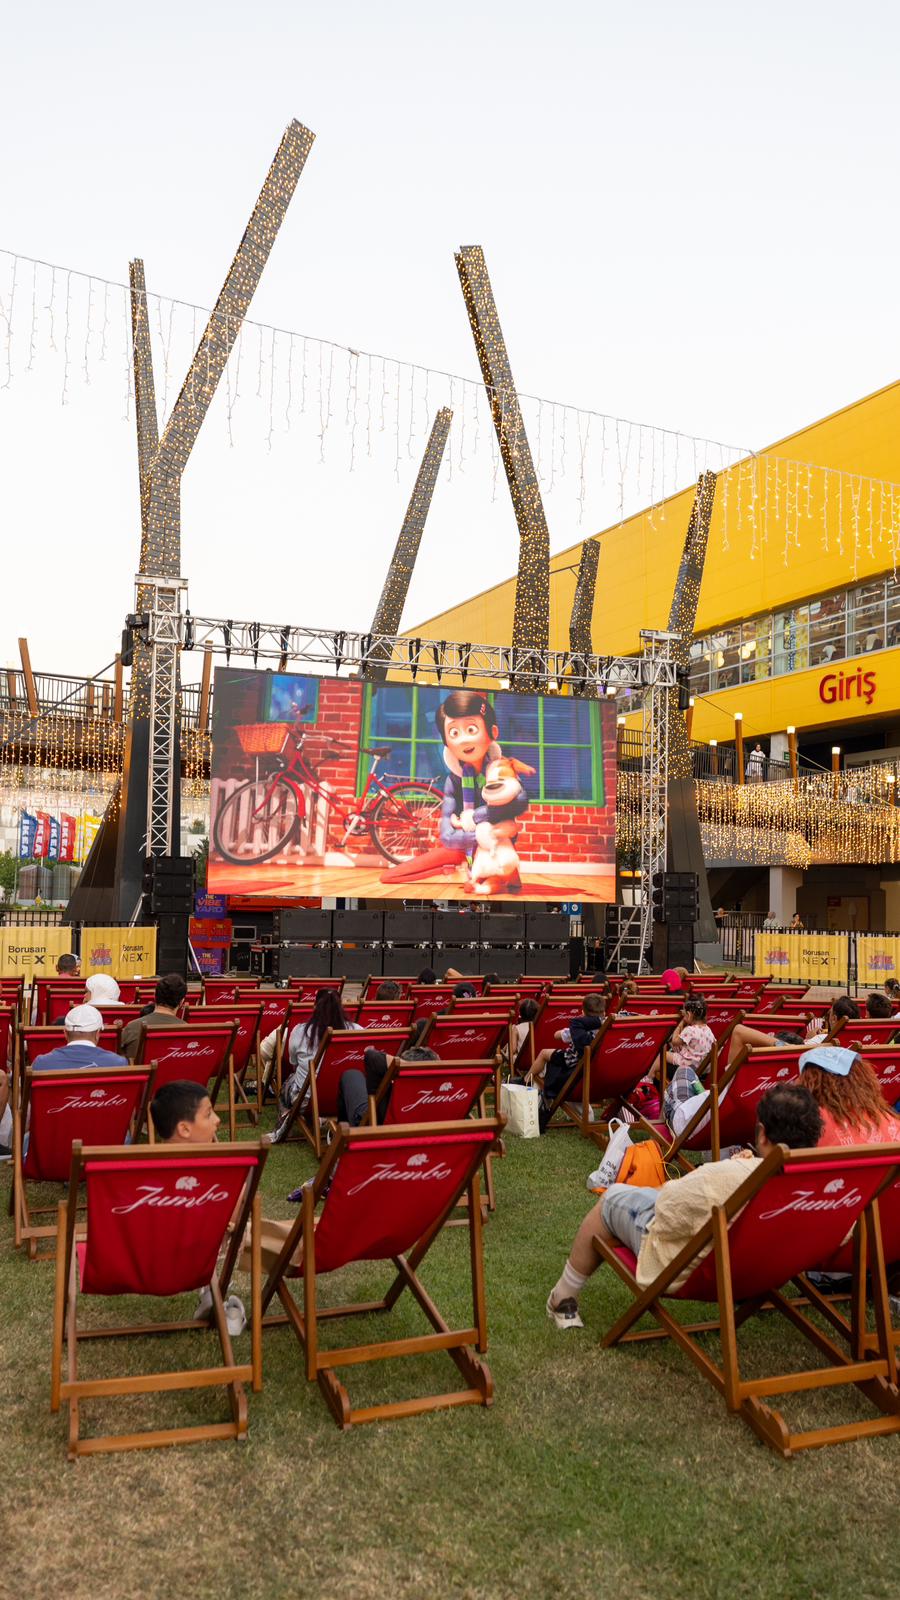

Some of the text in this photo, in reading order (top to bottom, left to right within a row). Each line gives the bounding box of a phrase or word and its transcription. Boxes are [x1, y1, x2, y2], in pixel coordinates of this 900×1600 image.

[819, 667, 877, 705] Giriş
[21, 819, 30, 856] IKEA
[34, 818, 44, 855] IKEA
[49, 822, 58, 857] IKEA
[60, 821, 69, 858] IKEA
[7, 955, 58, 965] NEXT
[8, 945, 47, 953] Borusan
[122, 944, 144, 952] Borusan
[122, 952, 150, 963] NEXT
[802, 957, 838, 966] NEXT
[157, 1046, 215, 1063] Jumbo
[605, 1037, 655, 1054] Jumbo
[47, 1093, 128, 1114] Jumbo
[401, 1088, 469, 1112] Jumbo
[347, 1162, 453, 1196] Jumbo
[111, 1183, 229, 1214] Jumbo
[759, 1187, 862, 1220] Jumbo
